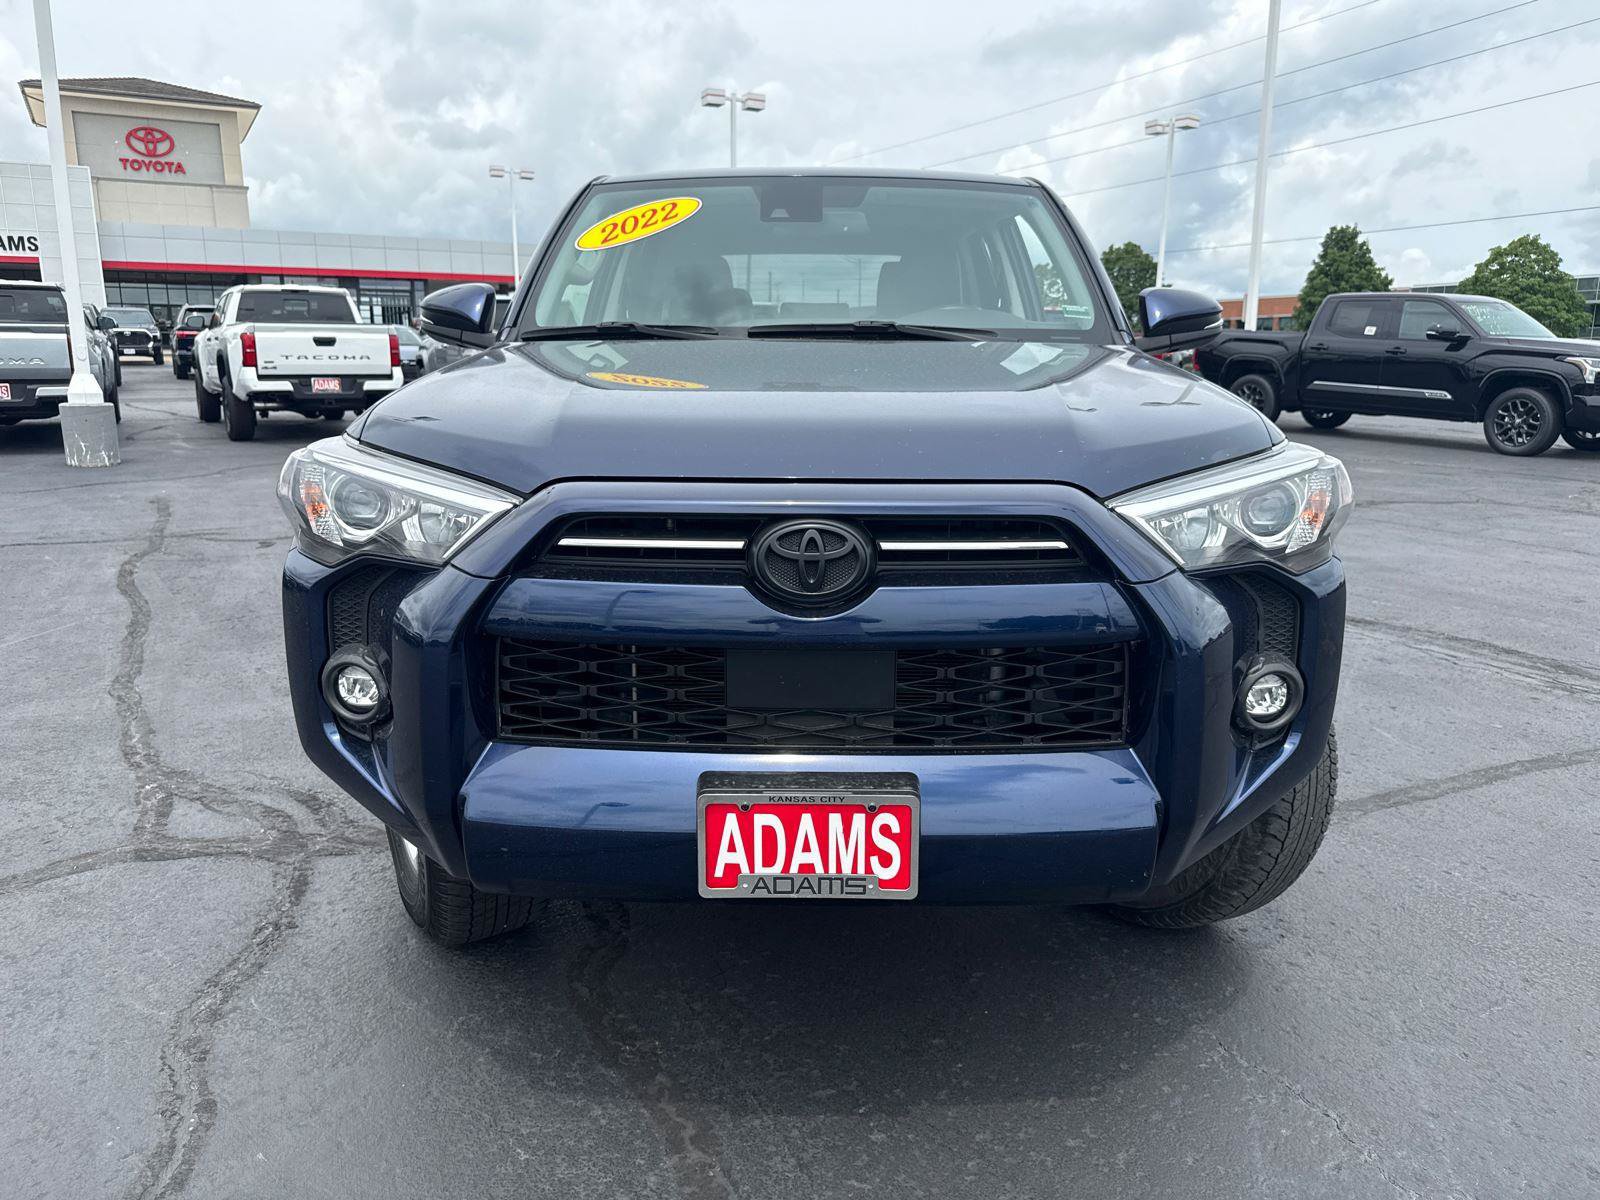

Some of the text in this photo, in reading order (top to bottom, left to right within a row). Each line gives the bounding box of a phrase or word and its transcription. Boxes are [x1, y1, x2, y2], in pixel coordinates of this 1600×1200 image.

[119, 158, 186, 175] TOYOTA
[600, 202, 679, 245] 2022
[314, 379, 340, 391] ADAMS
[714, 812, 901, 880] ADAMS
[750, 877, 867, 895] ADAMS
